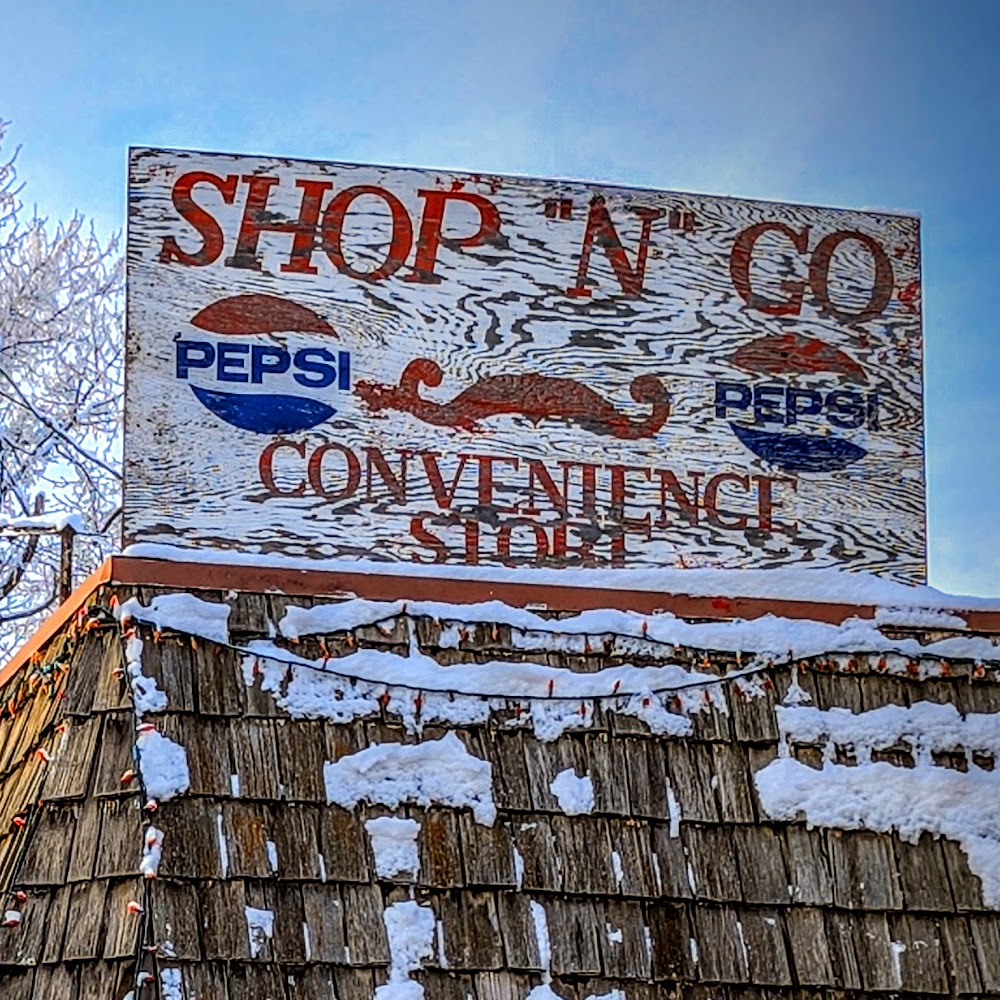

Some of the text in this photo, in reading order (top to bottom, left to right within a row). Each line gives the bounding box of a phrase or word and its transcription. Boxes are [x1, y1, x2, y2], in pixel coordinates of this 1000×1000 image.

[159, 171, 509, 284] SHOP
[729, 221, 895, 327] GO
[175, 339, 350, 391] PEPSI
[714, 381, 881, 432] PEPSI
[258, 440, 799, 534] CONVENIENCE
